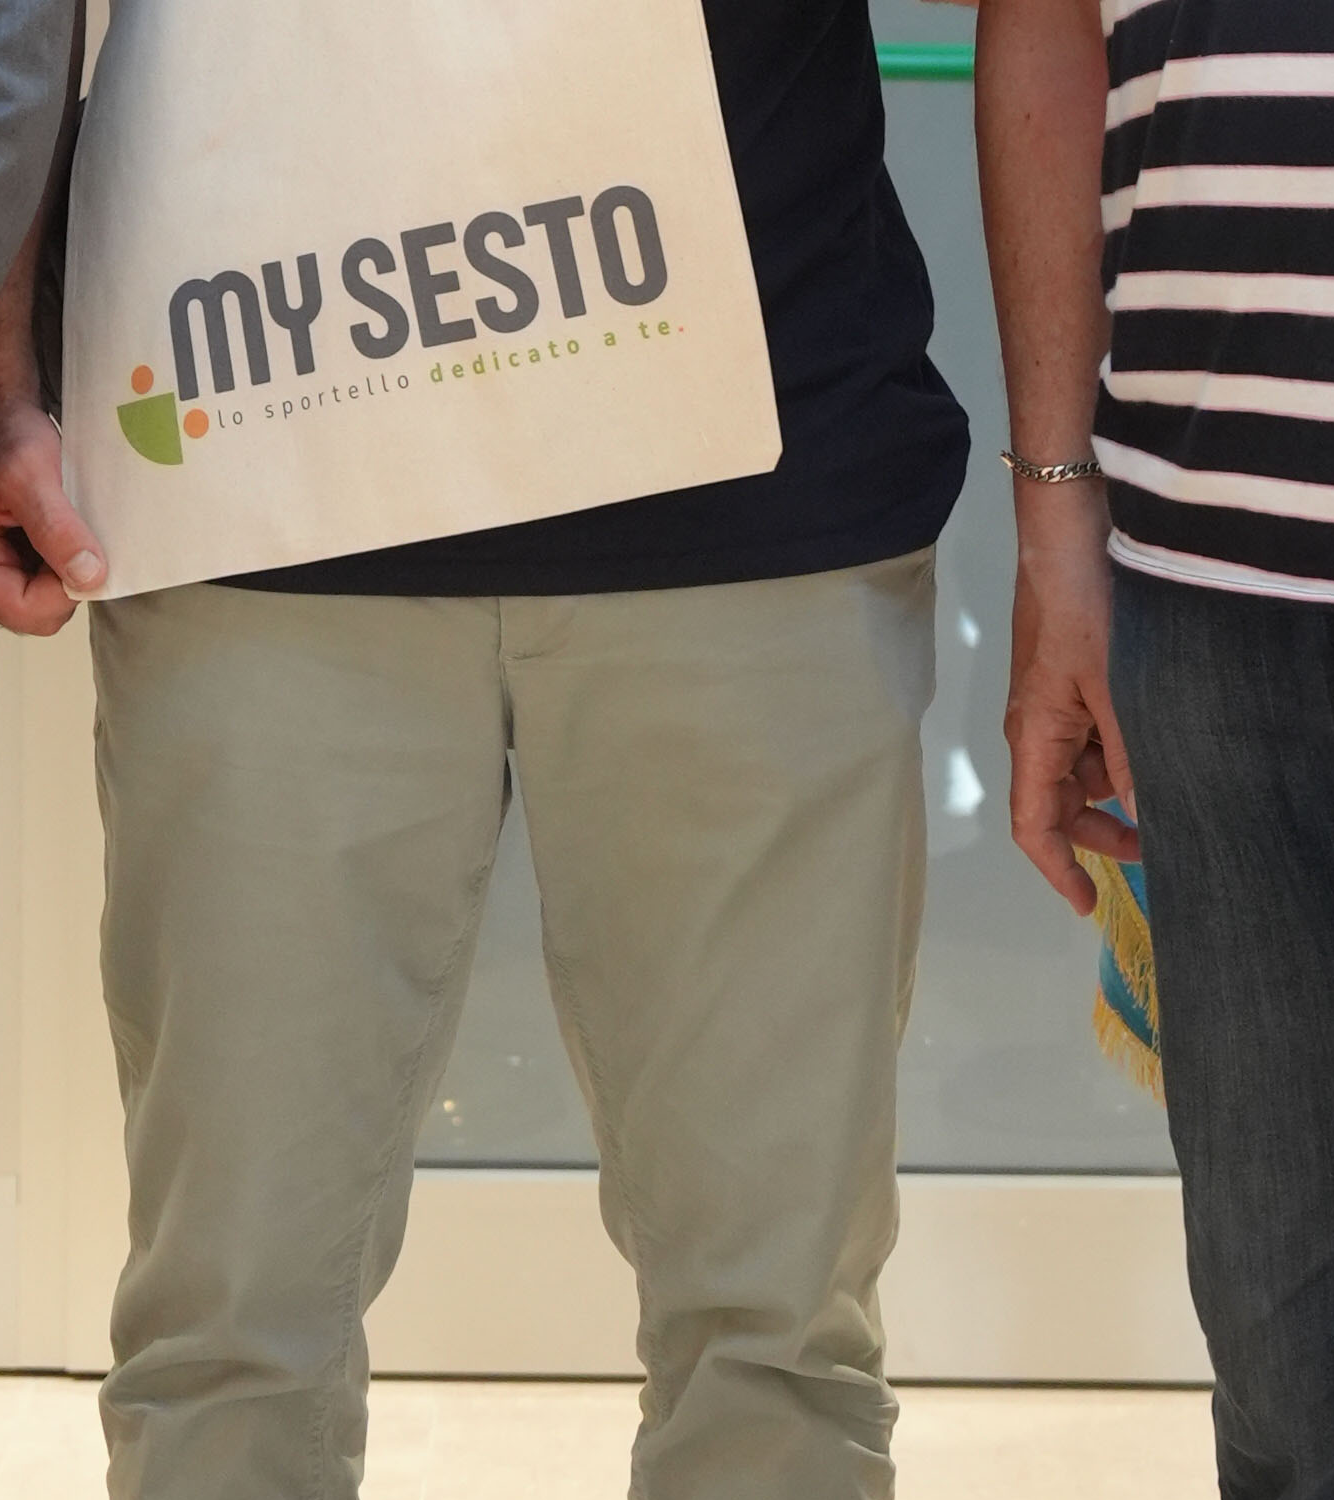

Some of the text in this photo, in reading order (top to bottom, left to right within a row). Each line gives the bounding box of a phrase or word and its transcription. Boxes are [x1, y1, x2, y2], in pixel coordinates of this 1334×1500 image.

[168, 185, 669, 402] MY SESTO
[217, 409, 244, 429] lo
[264, 373, 410, 419] sportello
[429, 339, 580, 384] dedicato
[603, 331, 617, 347] a
